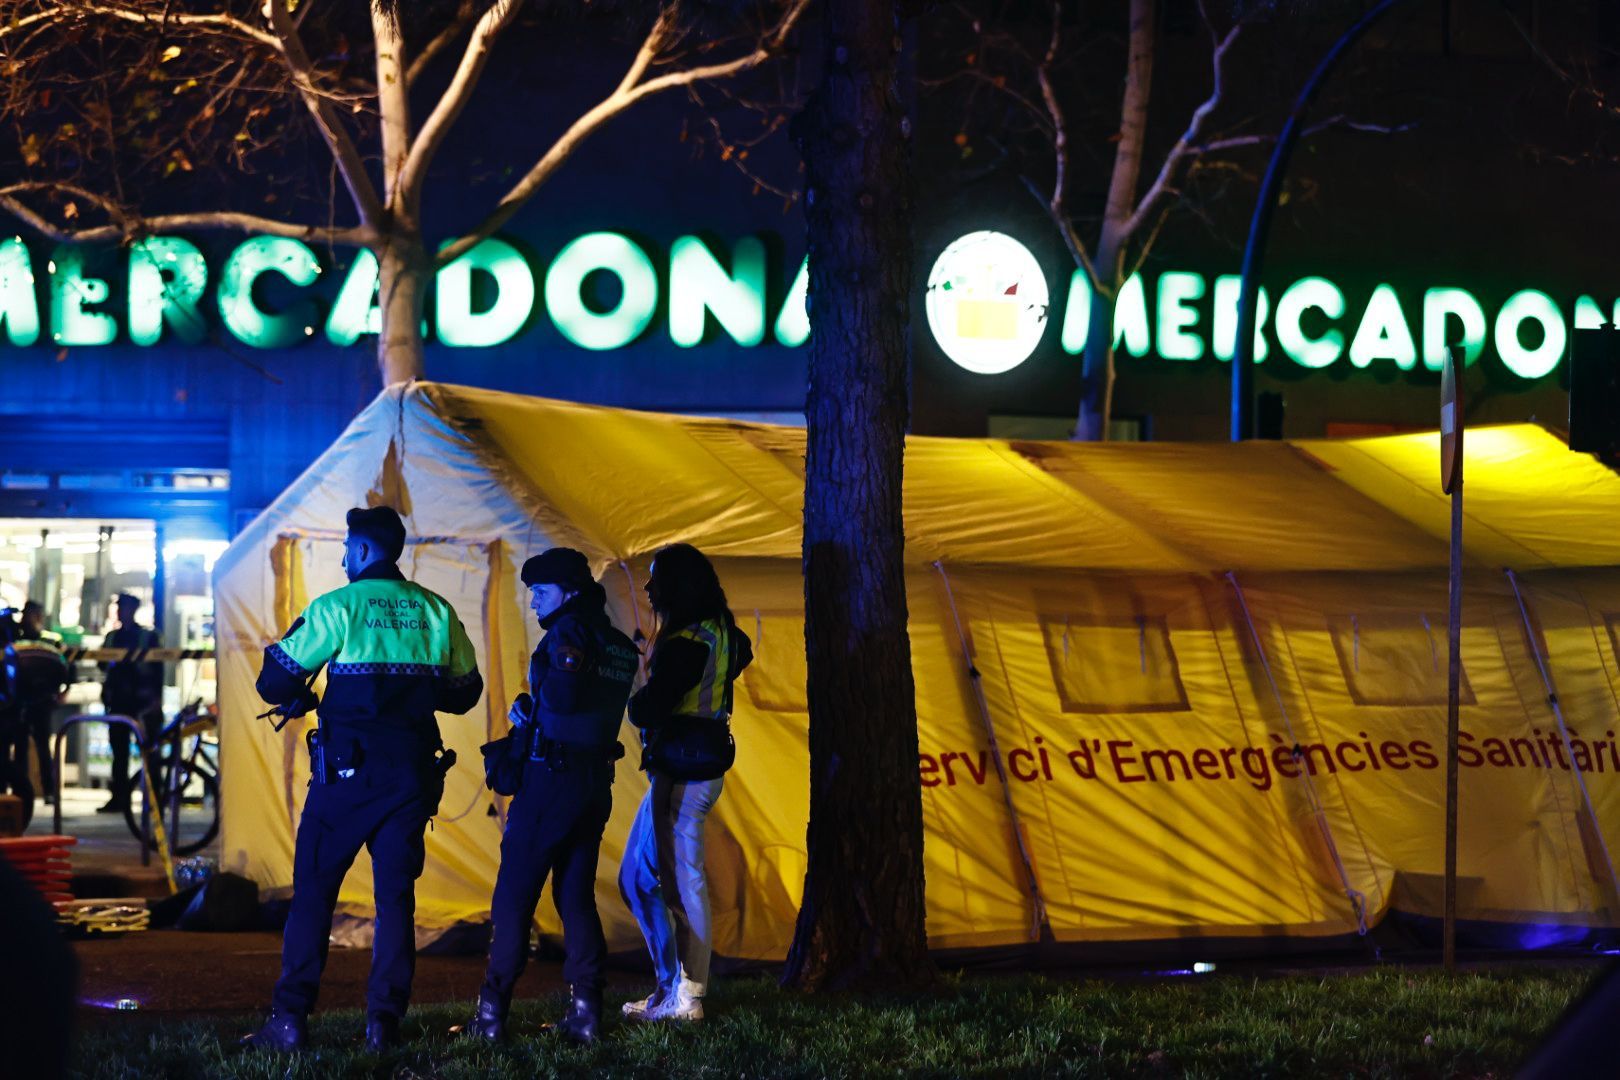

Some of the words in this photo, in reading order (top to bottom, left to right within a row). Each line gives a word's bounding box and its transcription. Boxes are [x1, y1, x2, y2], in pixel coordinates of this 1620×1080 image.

[365, 618, 431, 631] VALENCIA
[920, 736, 1053, 787] ervci
[1067, 731, 1440, 791] d'Emergències
